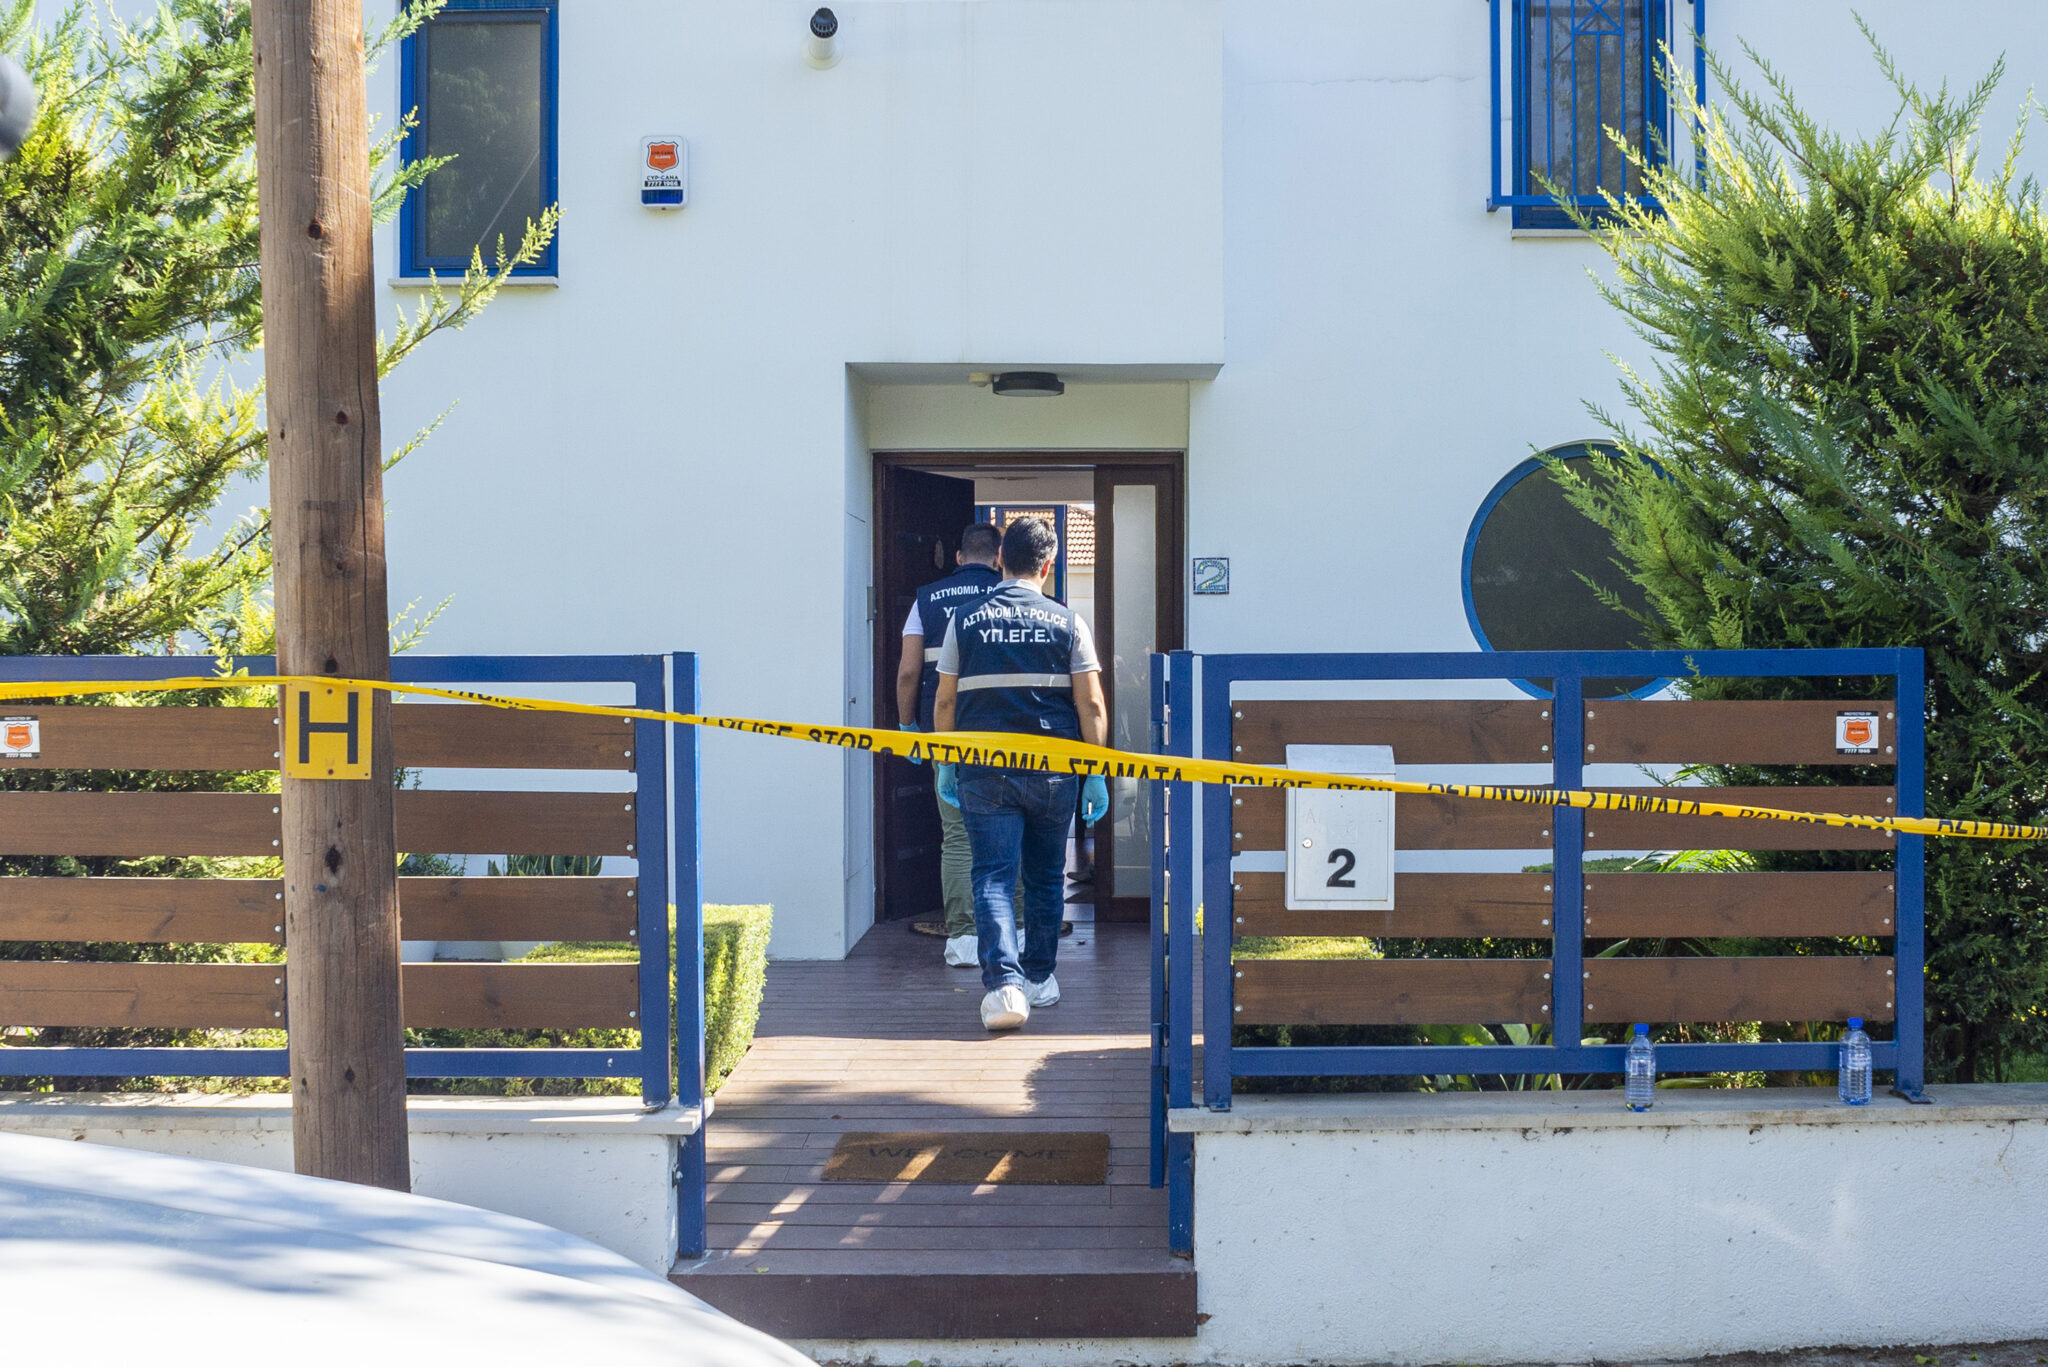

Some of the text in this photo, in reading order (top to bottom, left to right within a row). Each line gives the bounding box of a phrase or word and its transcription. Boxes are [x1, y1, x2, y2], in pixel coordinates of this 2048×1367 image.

[1196, 560, 1227, 592] 2
[930, 585, 979, 602] ΑΣΤΥΝΟΜΙΑ
[962, 606, 1022, 630] ΑΣΤΥΝΟΜΙΑ
[1029, 607, 1068, 628] POLICE
[298, 691, 359, 764] H
[1326, 848, 1356, 888] 2
